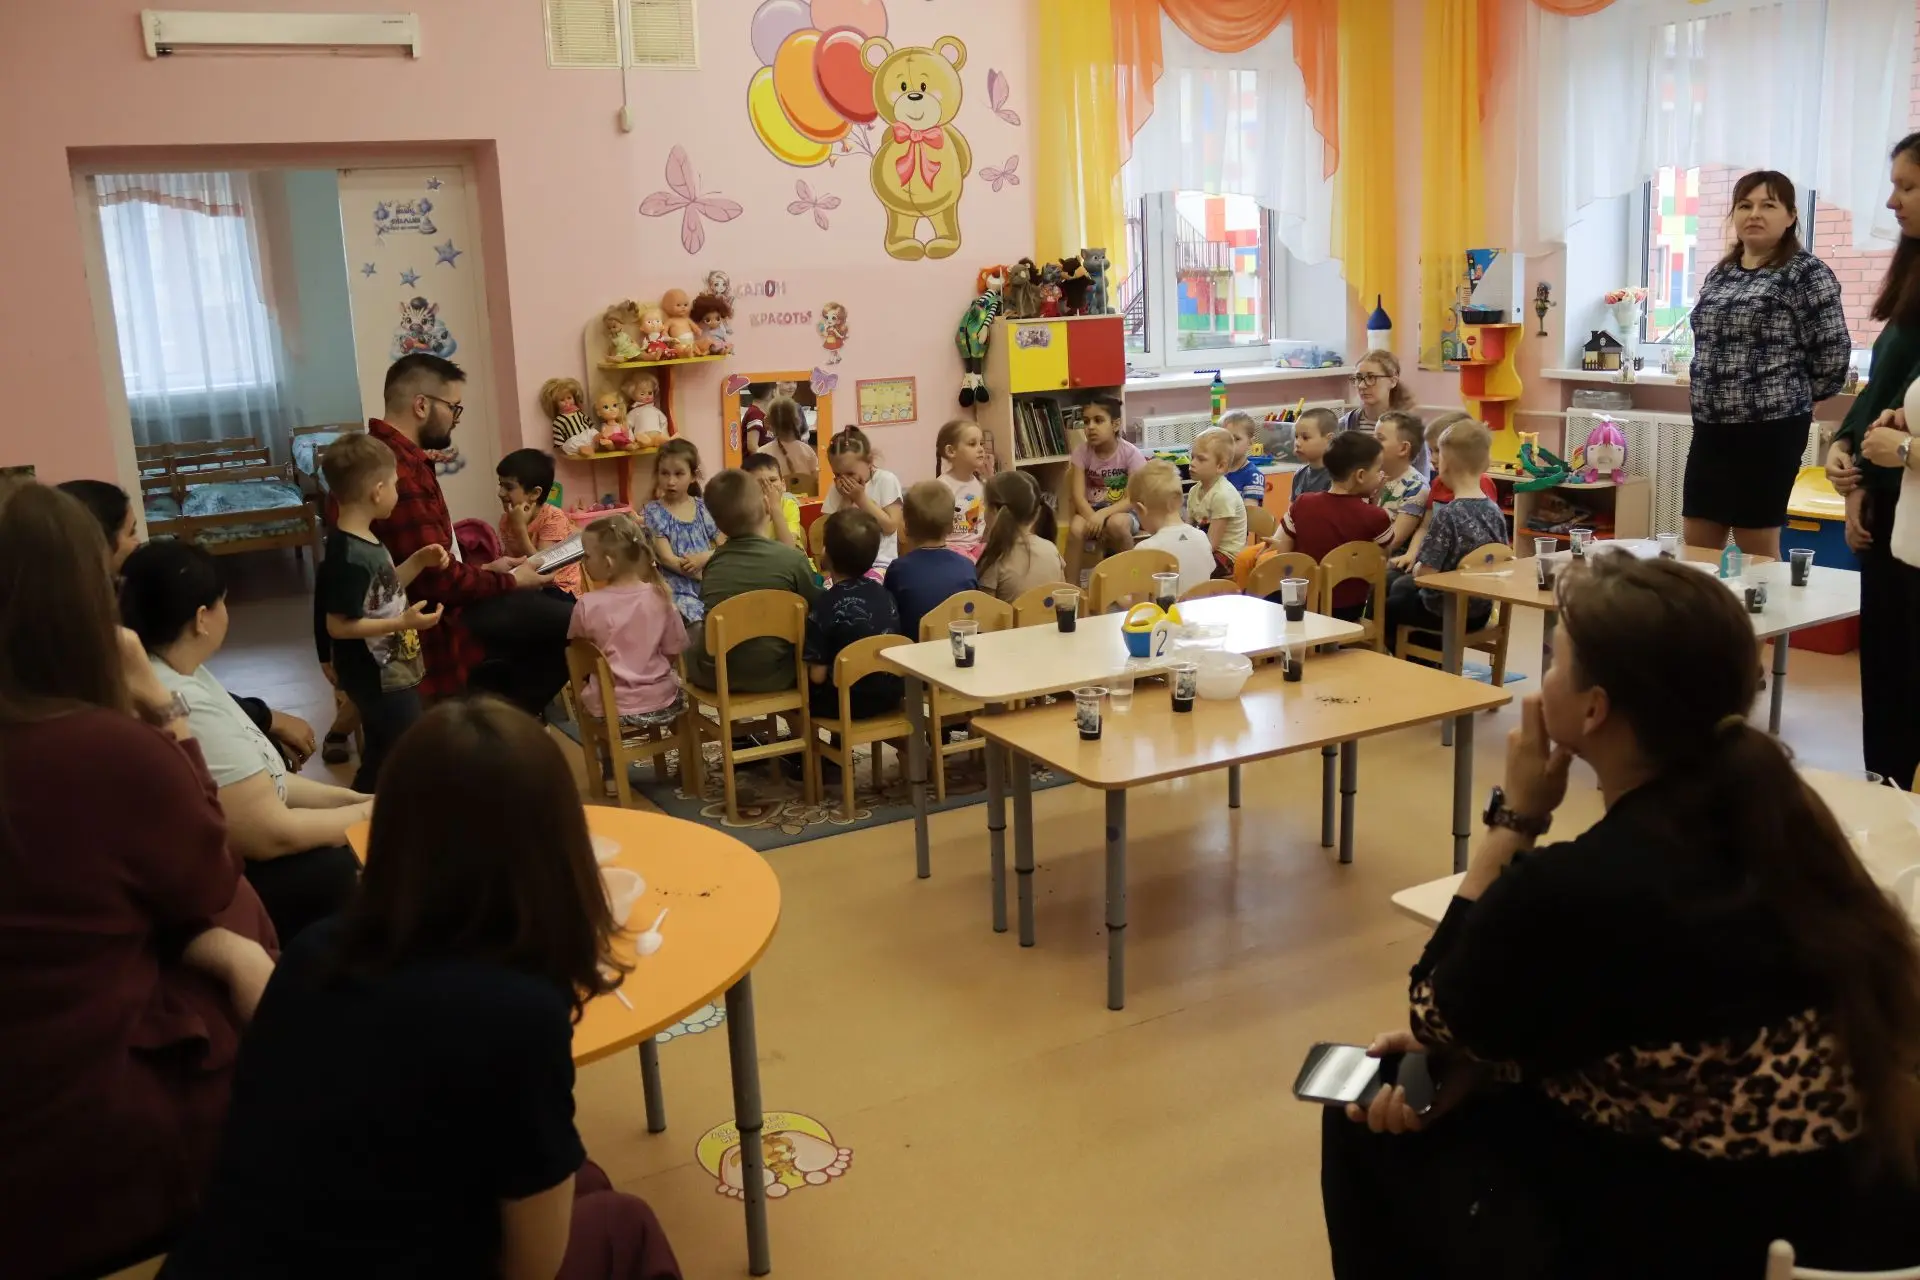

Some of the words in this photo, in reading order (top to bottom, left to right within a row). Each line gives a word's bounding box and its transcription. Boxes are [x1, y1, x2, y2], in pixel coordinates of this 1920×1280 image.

[749, 311, 812, 326] КРАСОТЫ
[1252, 473, 1264, 485] 30
[1156, 629, 1168, 656] 2
